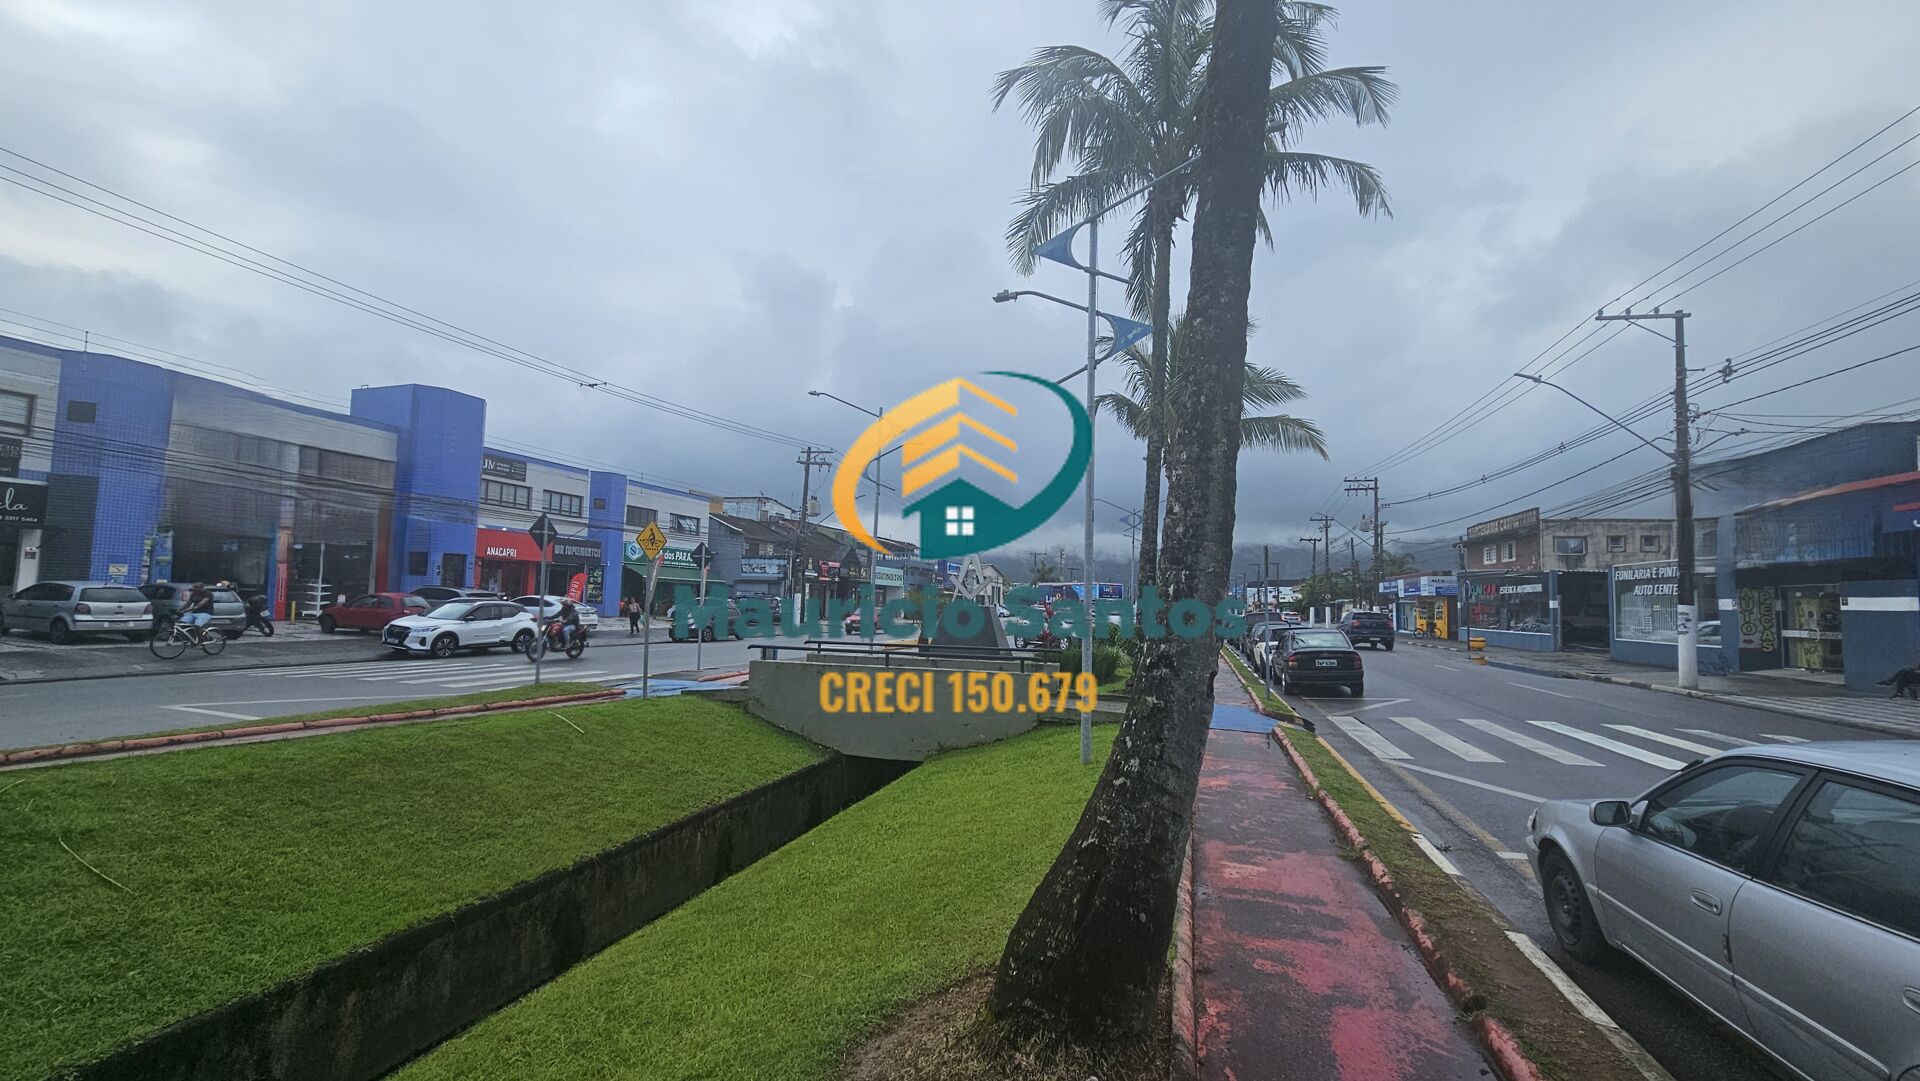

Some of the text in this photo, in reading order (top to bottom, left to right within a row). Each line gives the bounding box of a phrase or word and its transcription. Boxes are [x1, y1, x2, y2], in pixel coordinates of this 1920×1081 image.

[486, 546, 517, 558] ANACAPRI
[1615, 569, 1651, 580] FUNILARIA
[1652, 567, 1658, 578] E
[1634, 583, 1680, 596] AUTO CENTE
